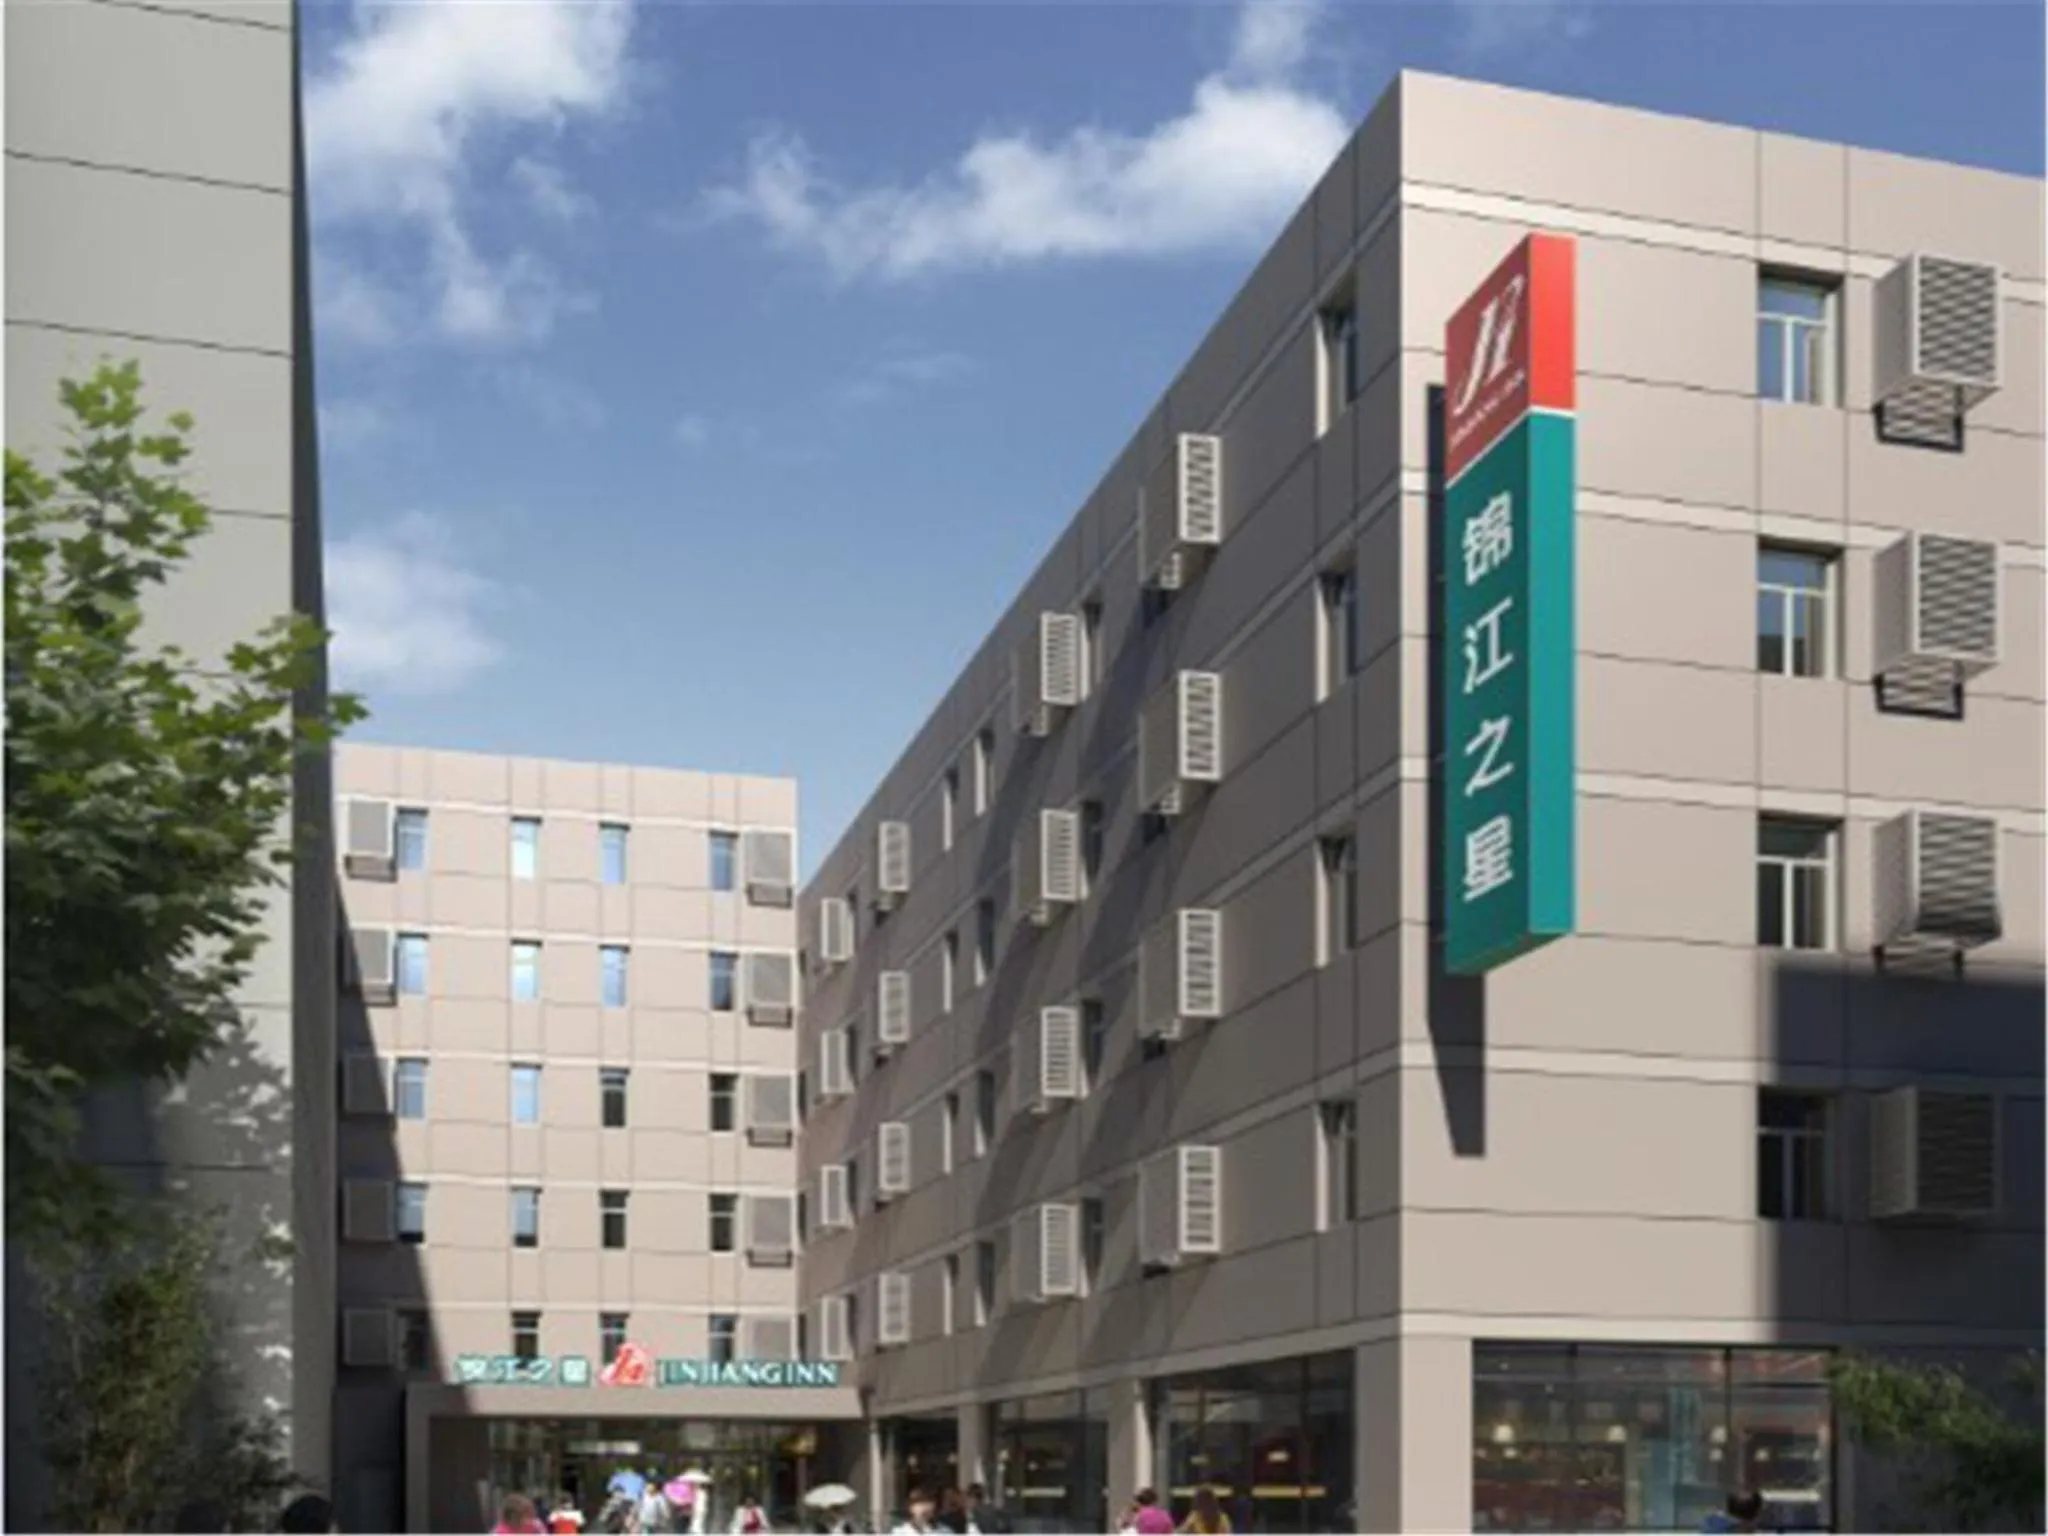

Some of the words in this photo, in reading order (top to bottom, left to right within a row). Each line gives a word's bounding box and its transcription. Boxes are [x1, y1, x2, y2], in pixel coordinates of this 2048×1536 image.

[1463, 491, 1513, 901] 锦江之星
[786, 1361, 838, 1385] INN
